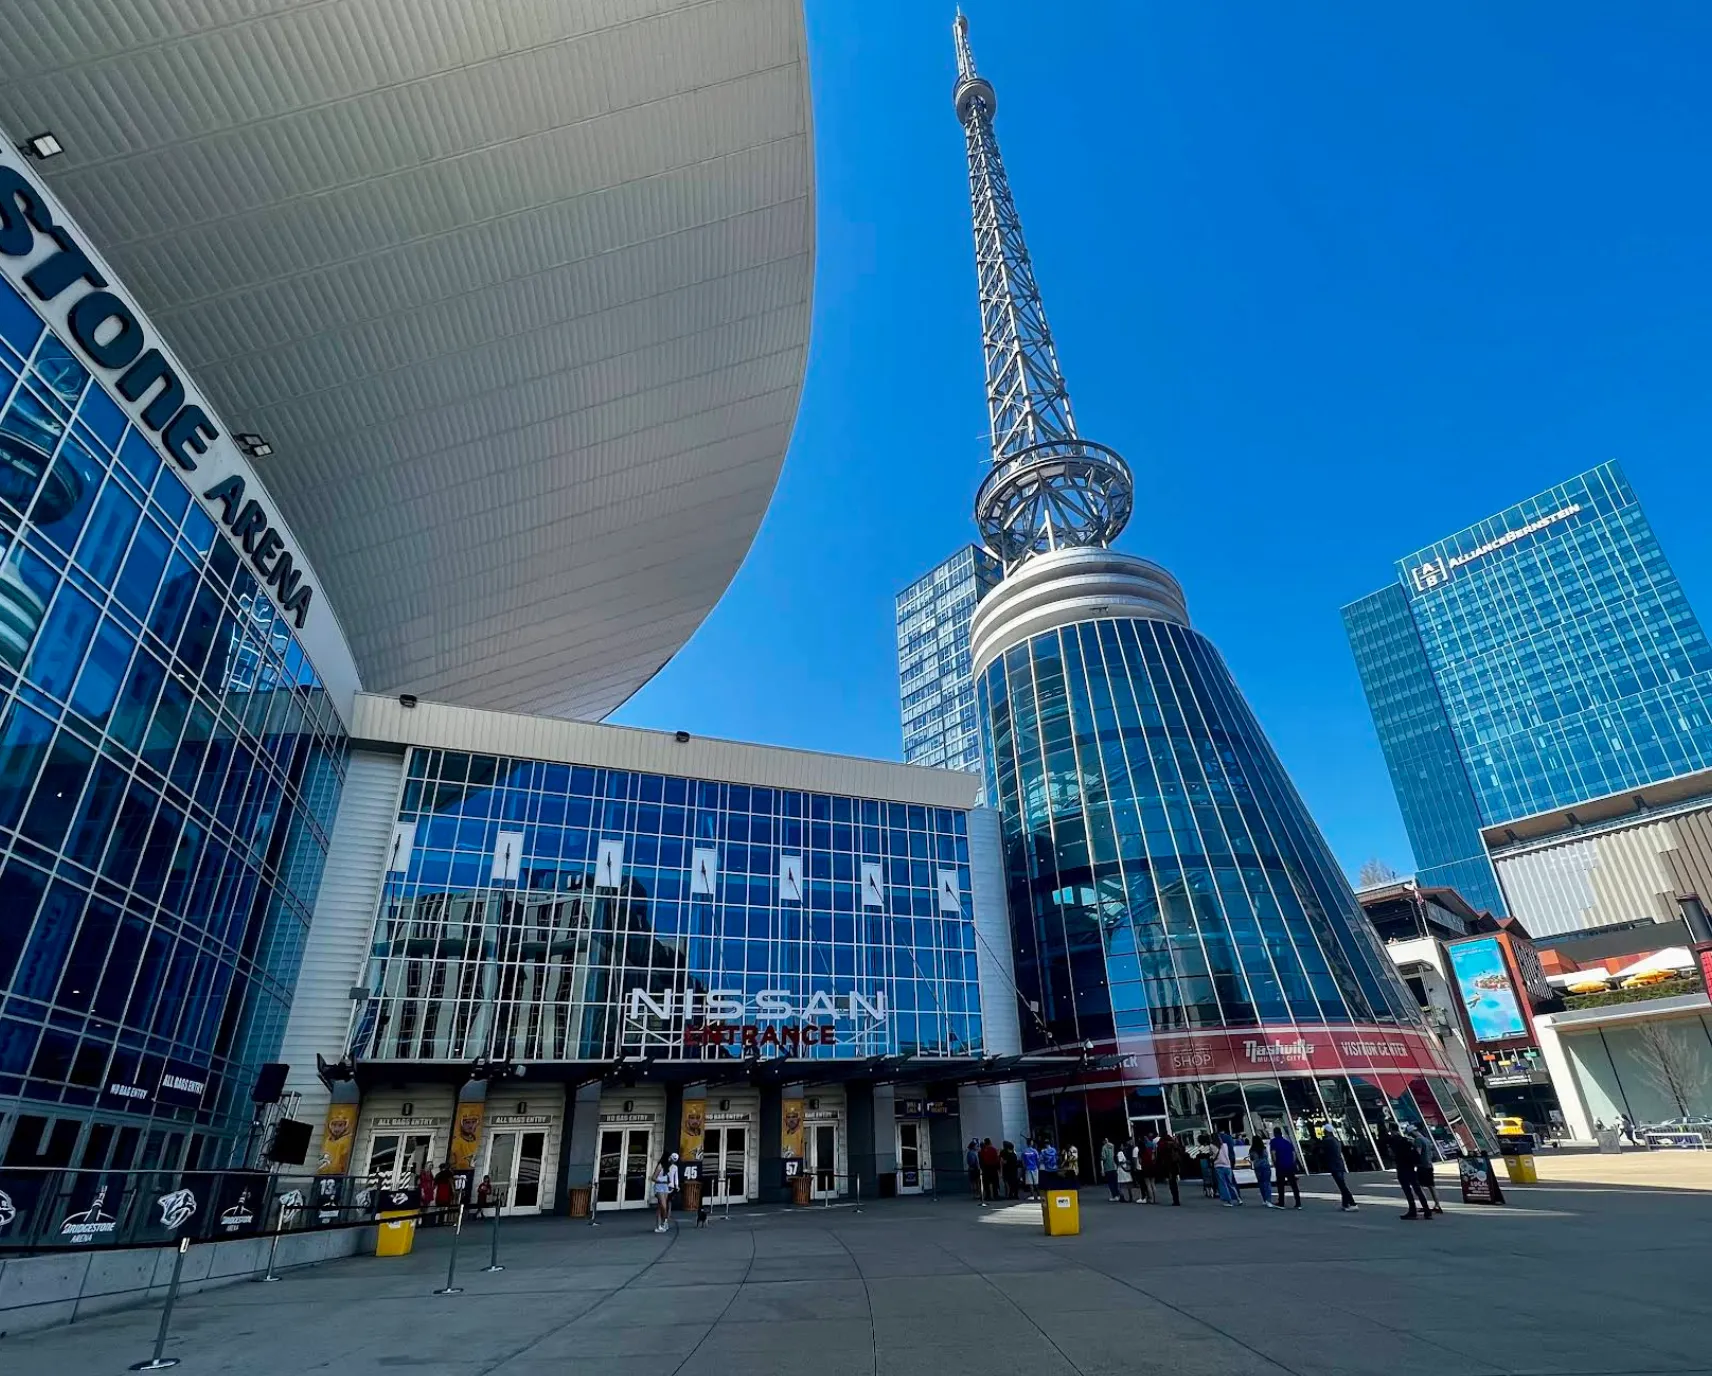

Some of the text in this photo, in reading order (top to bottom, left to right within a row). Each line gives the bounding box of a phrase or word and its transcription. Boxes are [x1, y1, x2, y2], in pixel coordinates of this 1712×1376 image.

[0, 148, 313, 628] STONE ARENA
[631, 988, 884, 1020] NISSAN
[684, 1024, 836, 1047] ENTRANCE
[1341, 1041, 1409, 1057] VISITOR CENTER
[1173, 1054, 1211, 1067] SHOP
[162, 1073, 174, 1088] ALL
[378, 1118, 434, 1126] ALL BAGS ENTRY
[684, 1166, 698, 1180] 45
[785, 1161, 799, 1176] 57
[320, 1179, 337, 1196] 13
[61, 1222, 117, 1235] BRIDGESTONE
[70, 1234, 93, 1243] ARENA
